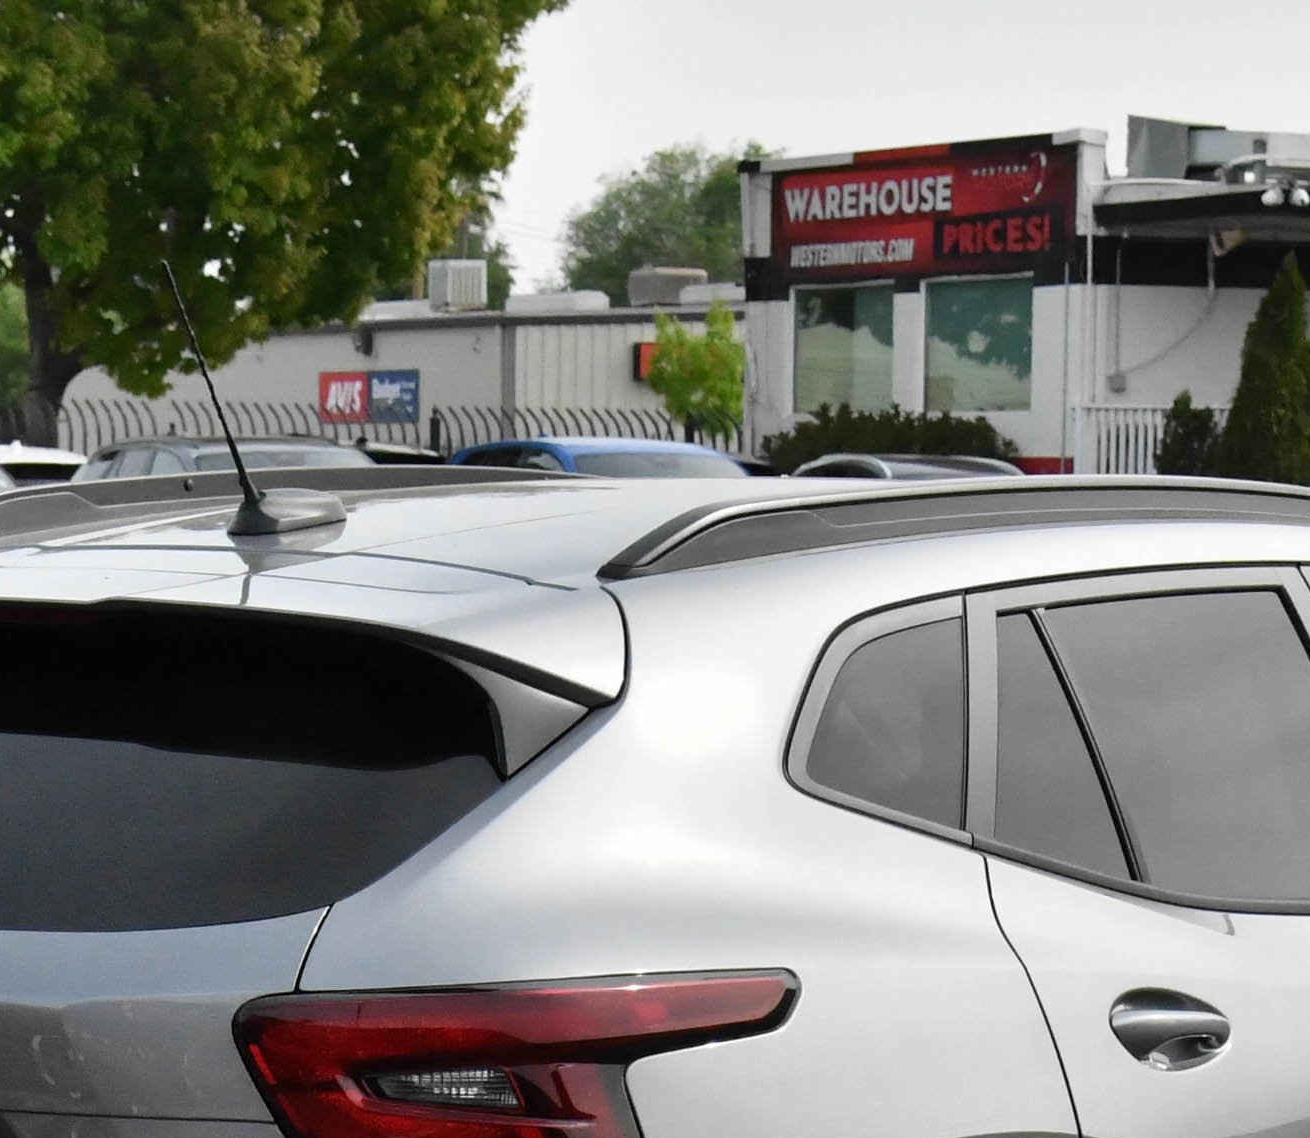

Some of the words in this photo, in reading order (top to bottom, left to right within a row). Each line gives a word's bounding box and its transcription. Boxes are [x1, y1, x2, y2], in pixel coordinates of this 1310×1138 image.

[784, 174, 954, 223] WAREHOUSE
[942, 210, 1051, 255] PRICES!
[789, 237, 916, 269] WESTERNMOTORS.COM
[326, 380, 363, 414] AVIS
